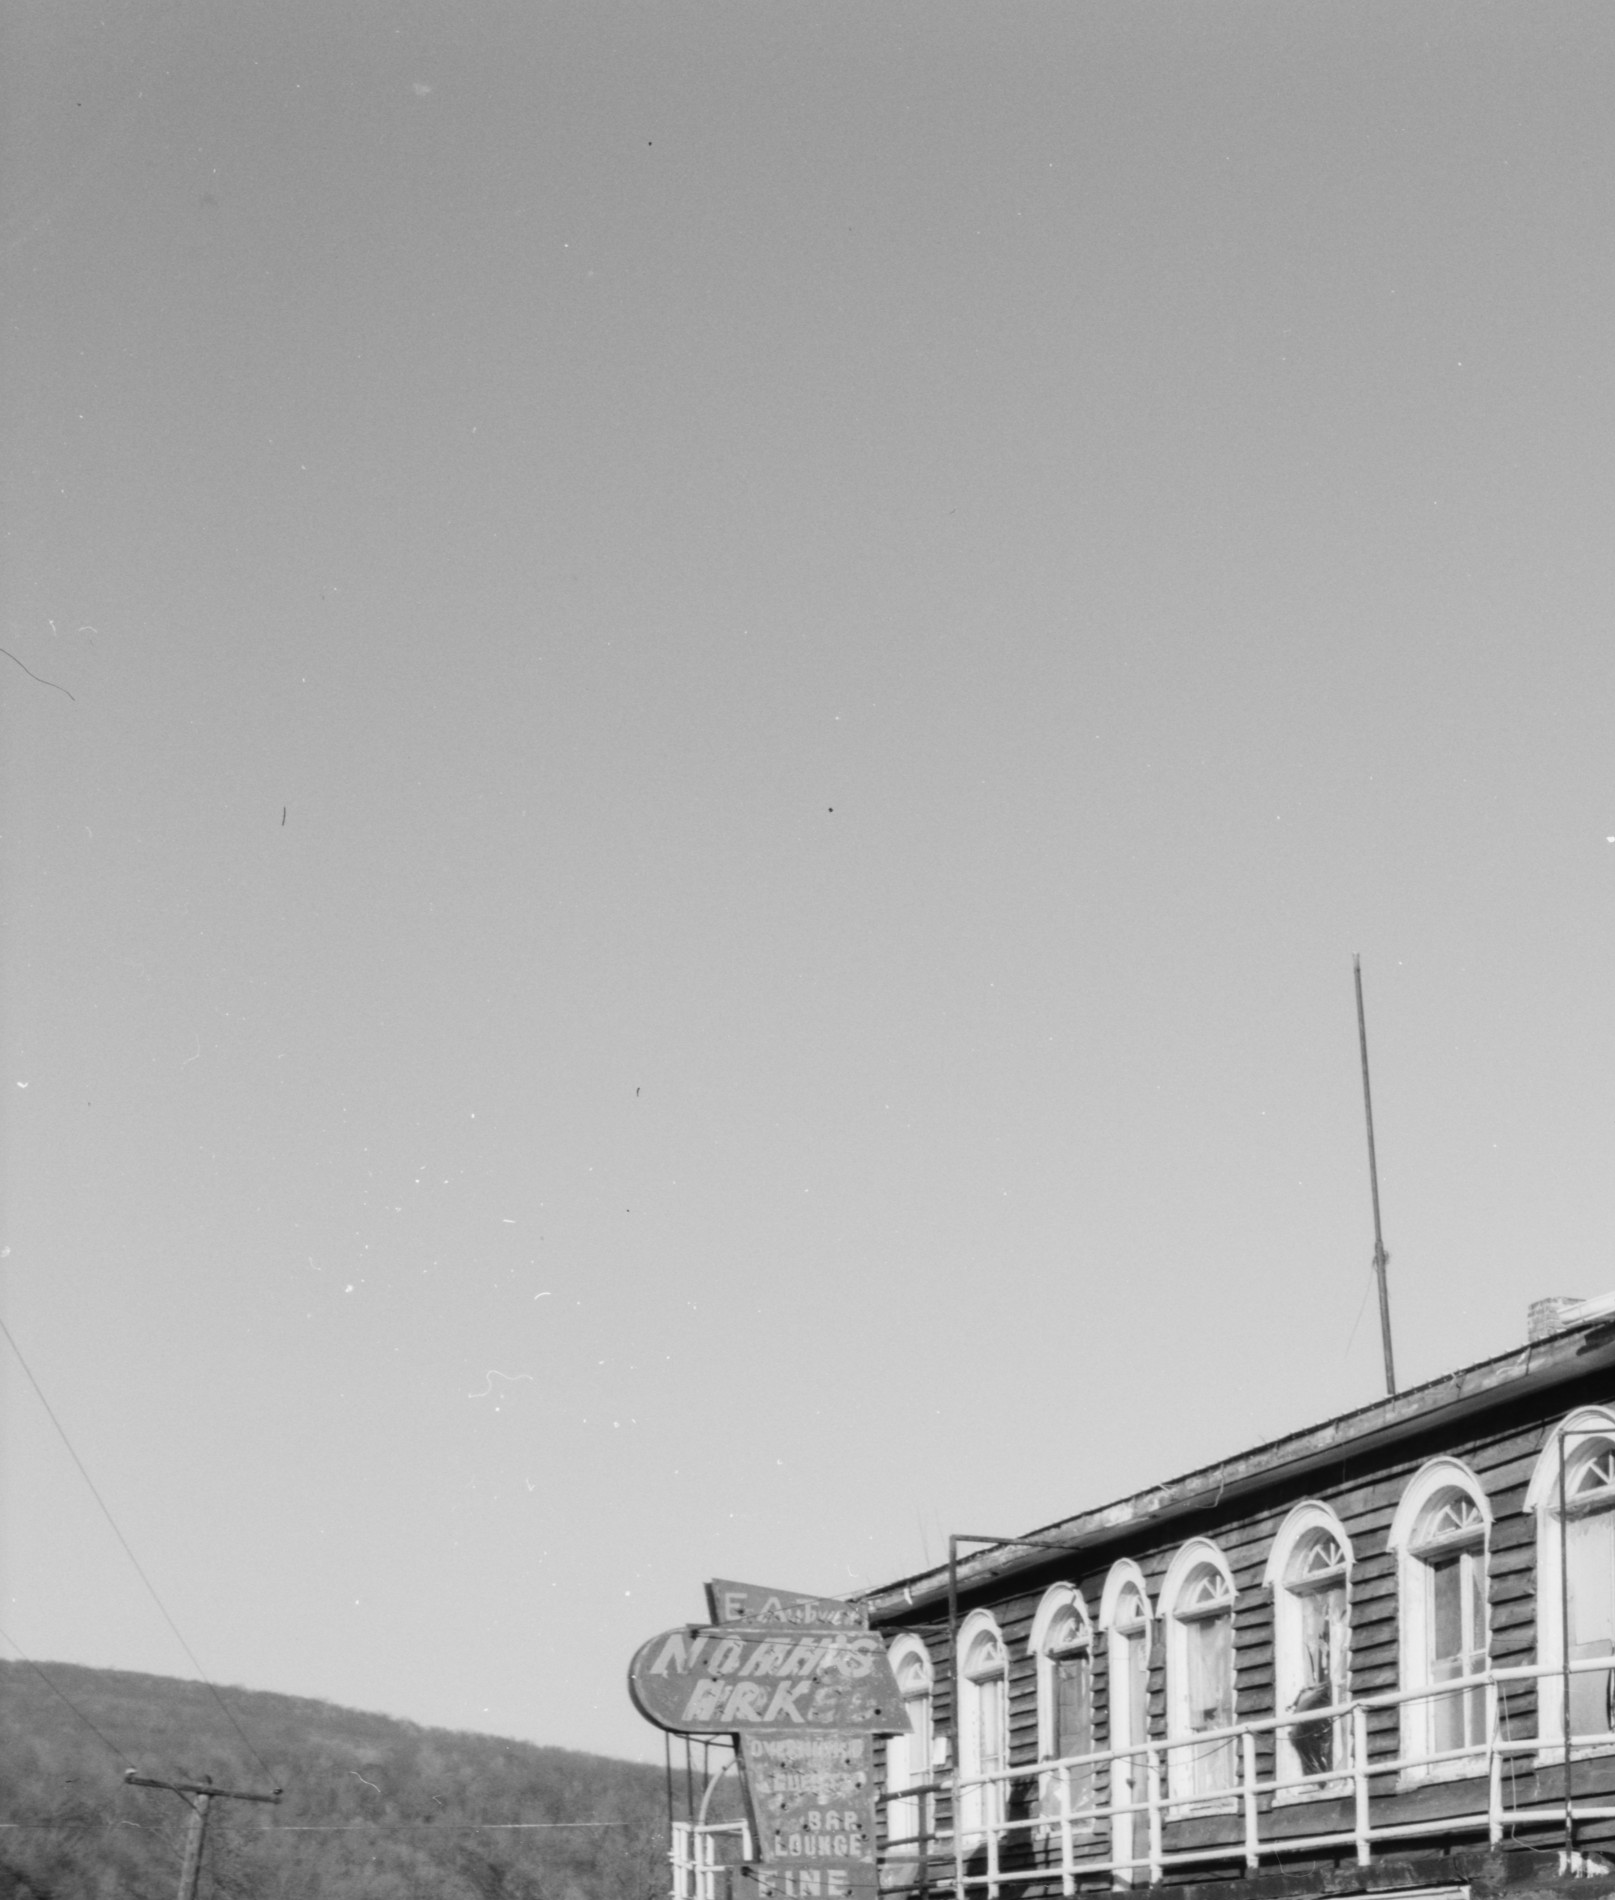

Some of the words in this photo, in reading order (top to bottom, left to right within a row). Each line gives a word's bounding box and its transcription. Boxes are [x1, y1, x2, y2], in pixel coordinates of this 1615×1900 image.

[808, 1810, 861, 1831] BAR
[774, 1833, 862, 1857] LOUNGE
[758, 1869, 848, 1898] FINE
